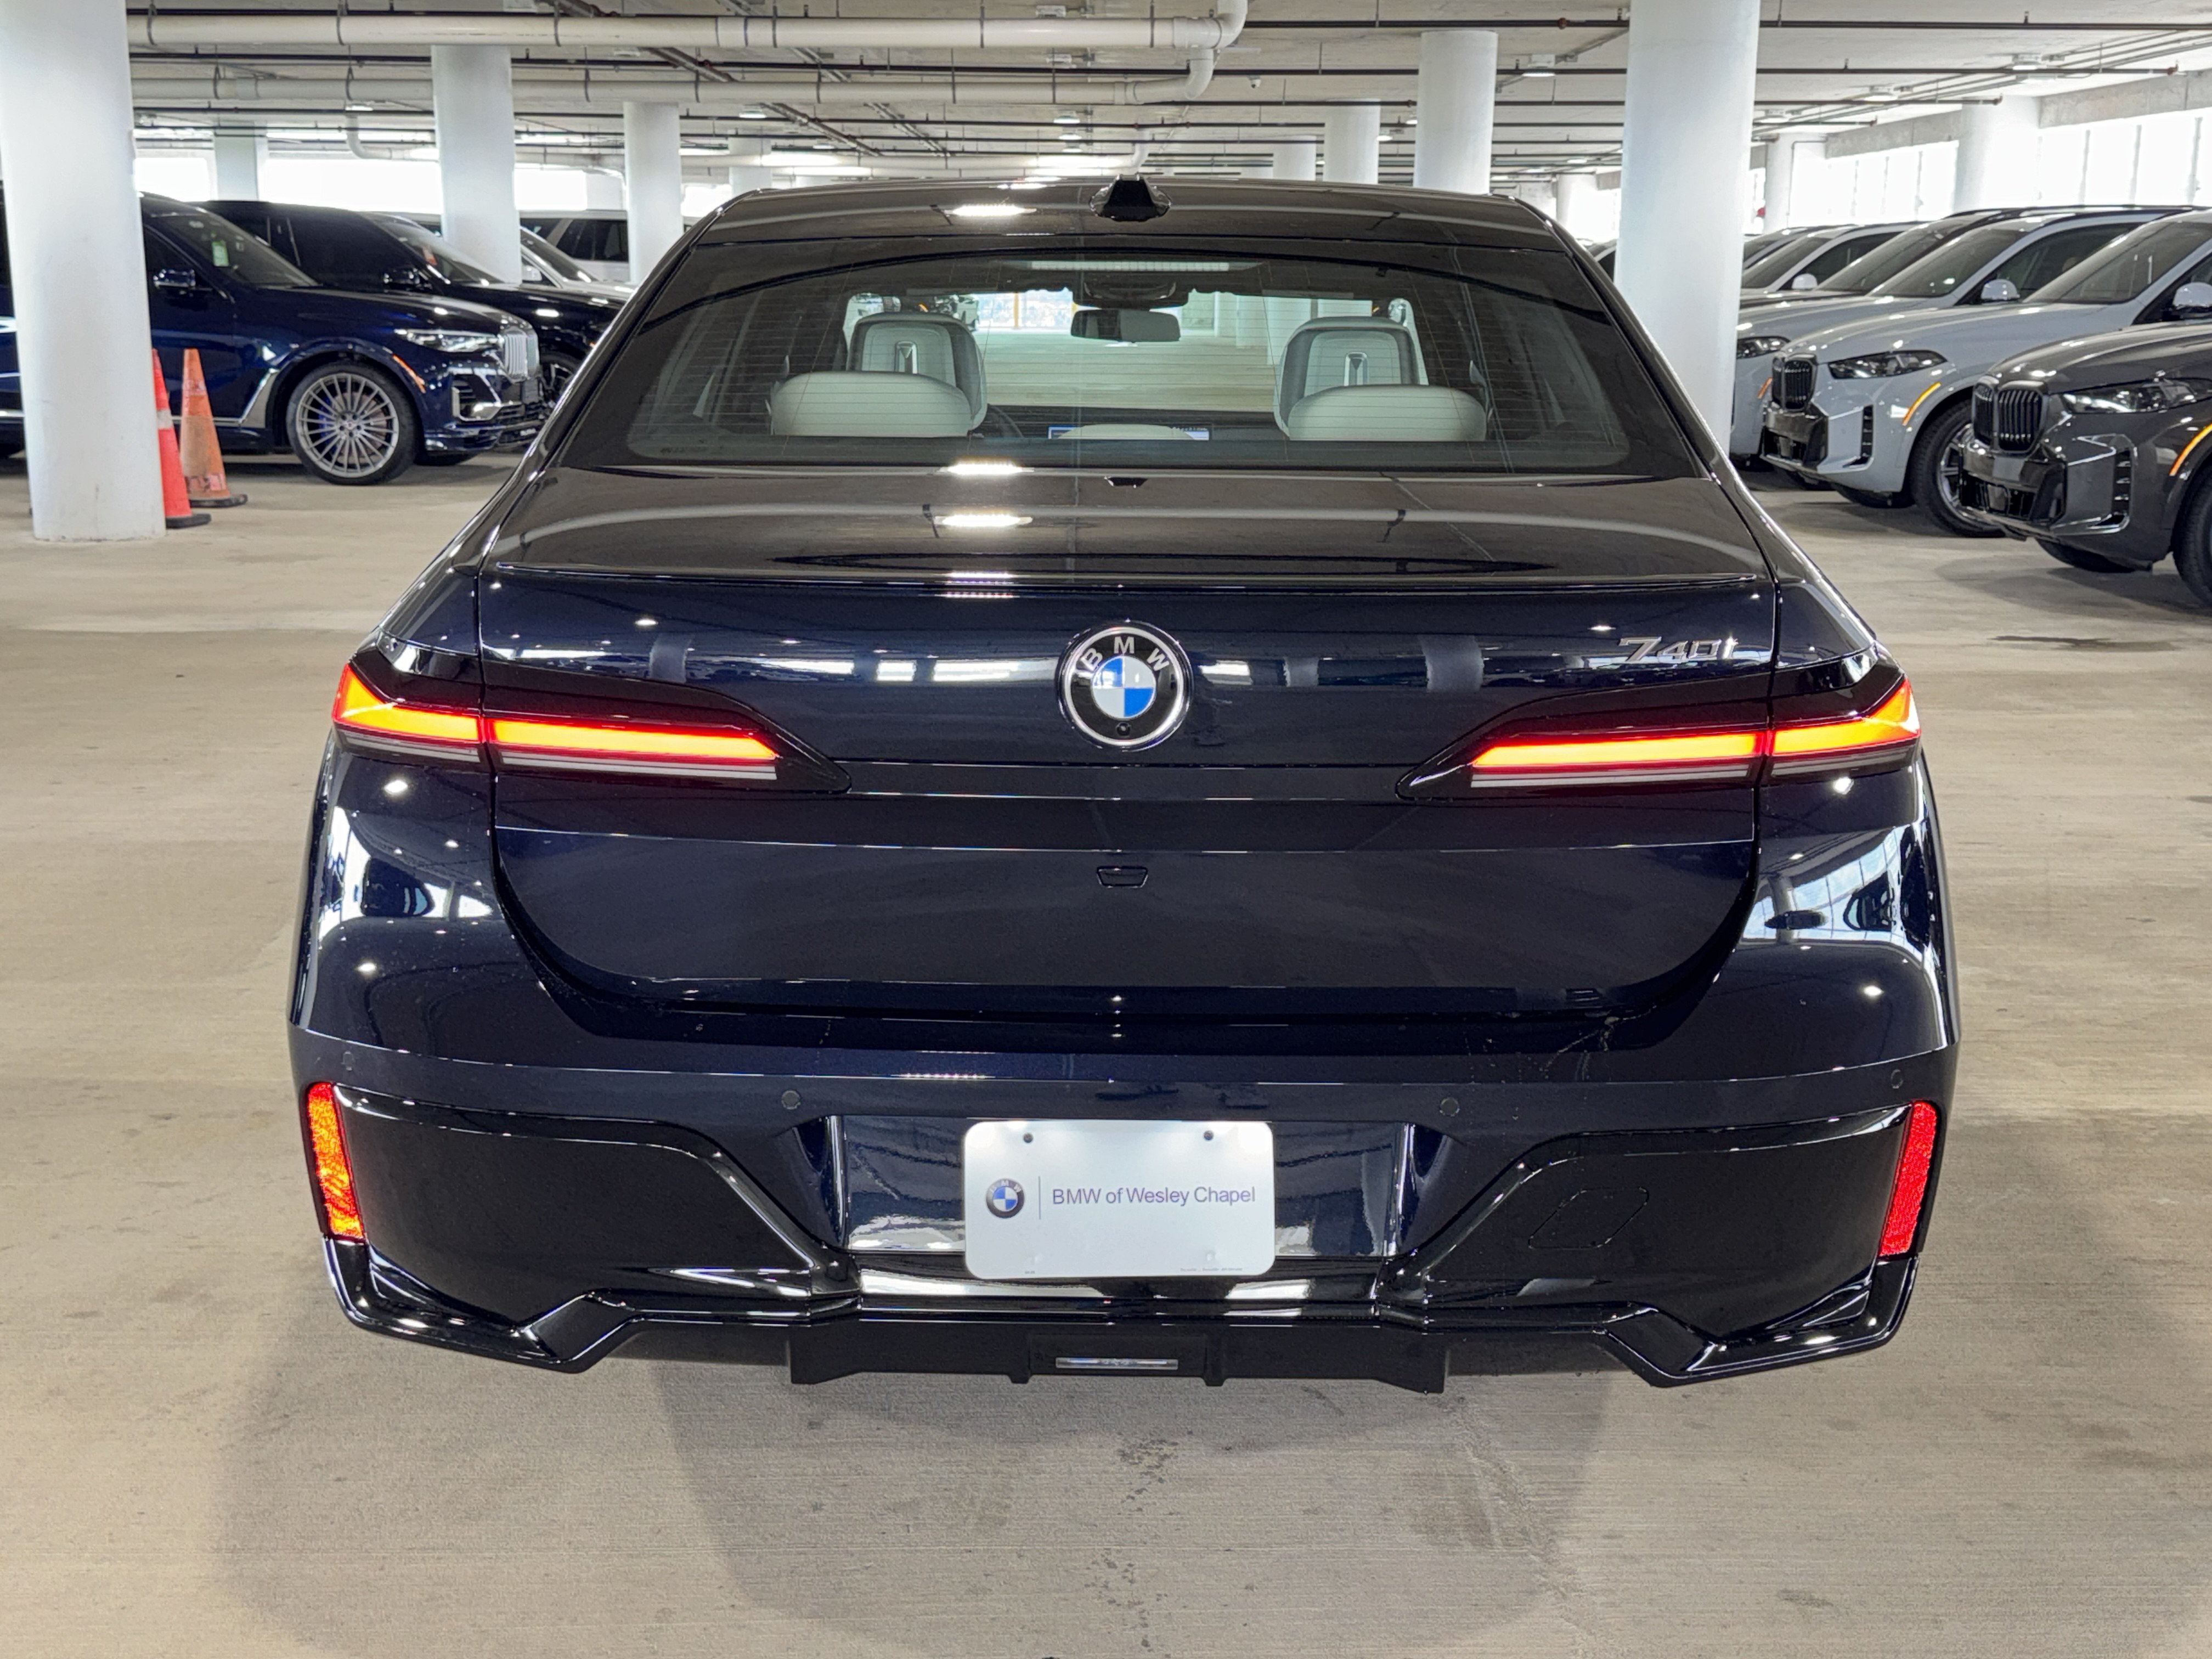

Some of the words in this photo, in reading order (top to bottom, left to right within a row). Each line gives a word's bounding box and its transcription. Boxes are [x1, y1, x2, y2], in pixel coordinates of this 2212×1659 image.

[1080, 636, 1170, 672] BMW
[1619, 636, 1738, 662] 740i
[1052, 1188, 1101, 1205] BMW
[1105, 1187, 1124, 1204] of
[1126, 1187, 1189, 1207] Wesley
[1193, 1186, 1256, 1206] Chapel
